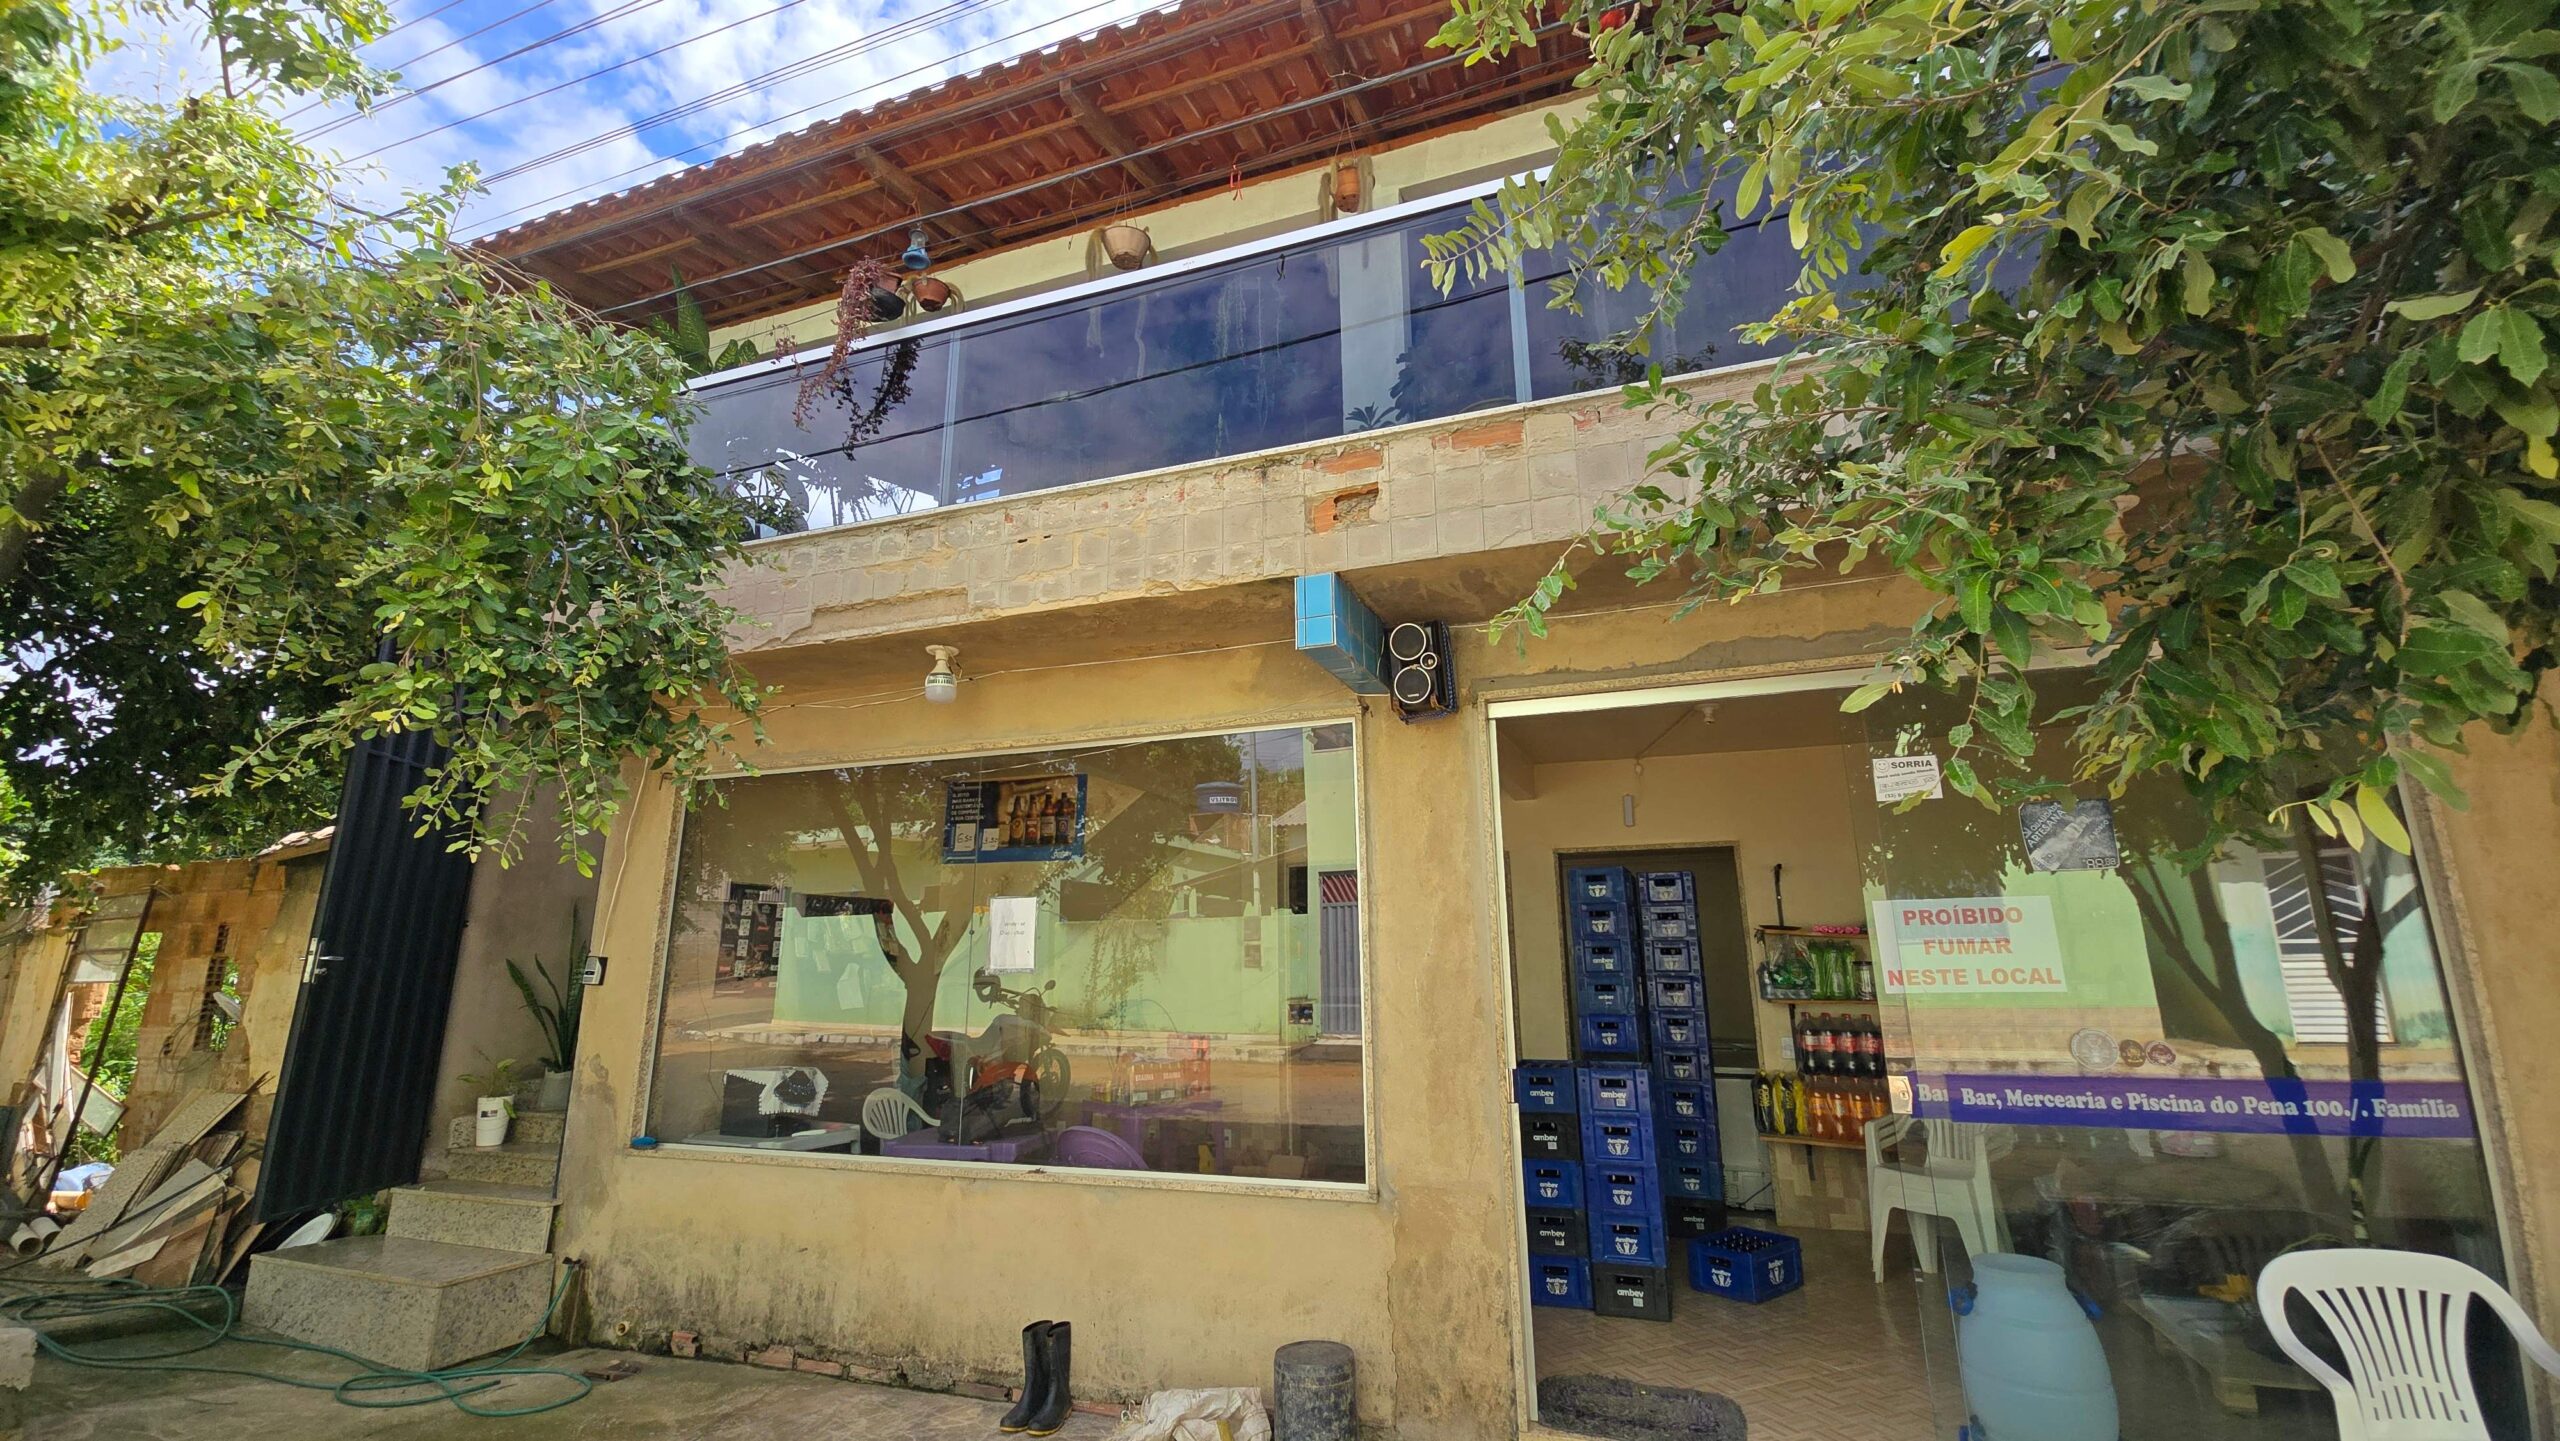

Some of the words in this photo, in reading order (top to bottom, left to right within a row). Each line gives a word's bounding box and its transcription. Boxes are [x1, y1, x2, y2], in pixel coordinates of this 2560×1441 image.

[1891, 760, 1932, 769] SORRIA
[2027, 810, 2067, 848] ARTESANA
[1903, 905, 2023, 926] PROÍBIDO
[1923, 938, 2013, 956] FUMAR
[1888, 968, 1969, 987] NESTE
[1976, 967, 2062, 985] LOCAL
[1529, 1089, 1555, 1097] ambev
[1600, 1090, 1627, 1099] ambev
[1960, 1088, 2002, 1110] Bar,
[2005, 1088, 2108, 1110] Mercearia
[2111, 1095, 2124, 1110] e
[2126, 1092, 2206, 1114] Piscina
[2210, 1096, 2238, 1115] do
[2241, 1096, 2299, 1116] Pena
[1533, 1133, 1558, 1142] ambev
[1539, 1229, 1565, 1238] ambev
[1616, 1288, 1645, 1298] ambev
